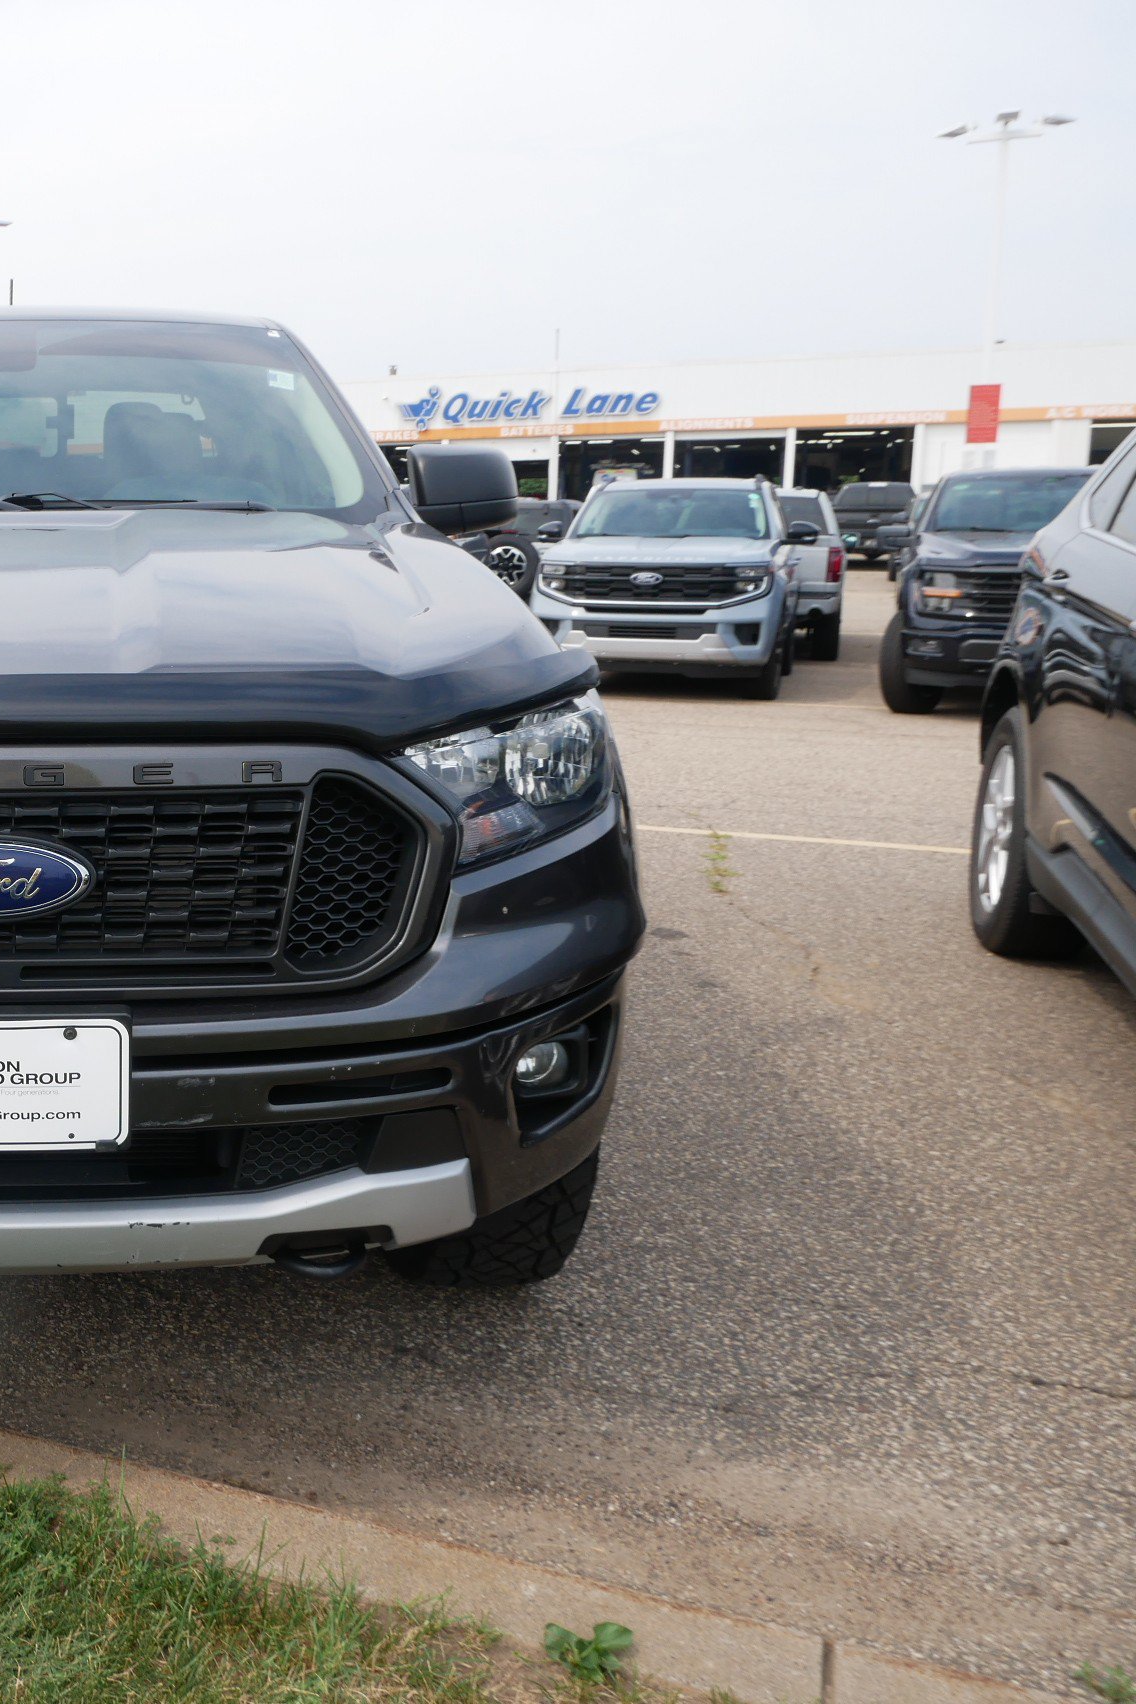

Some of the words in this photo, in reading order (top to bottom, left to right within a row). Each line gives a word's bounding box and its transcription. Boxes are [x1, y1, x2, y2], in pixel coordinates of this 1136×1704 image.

[441, 389, 552, 425] Quick
[561, 386, 662, 418] Lane
[845, 411, 948, 424] SUSPENSION
[500, 424, 575, 438] BATTERIES
[658, 418, 755, 431] ALIGNMENTS
[9, 1072, 81, 1085] GROUP
